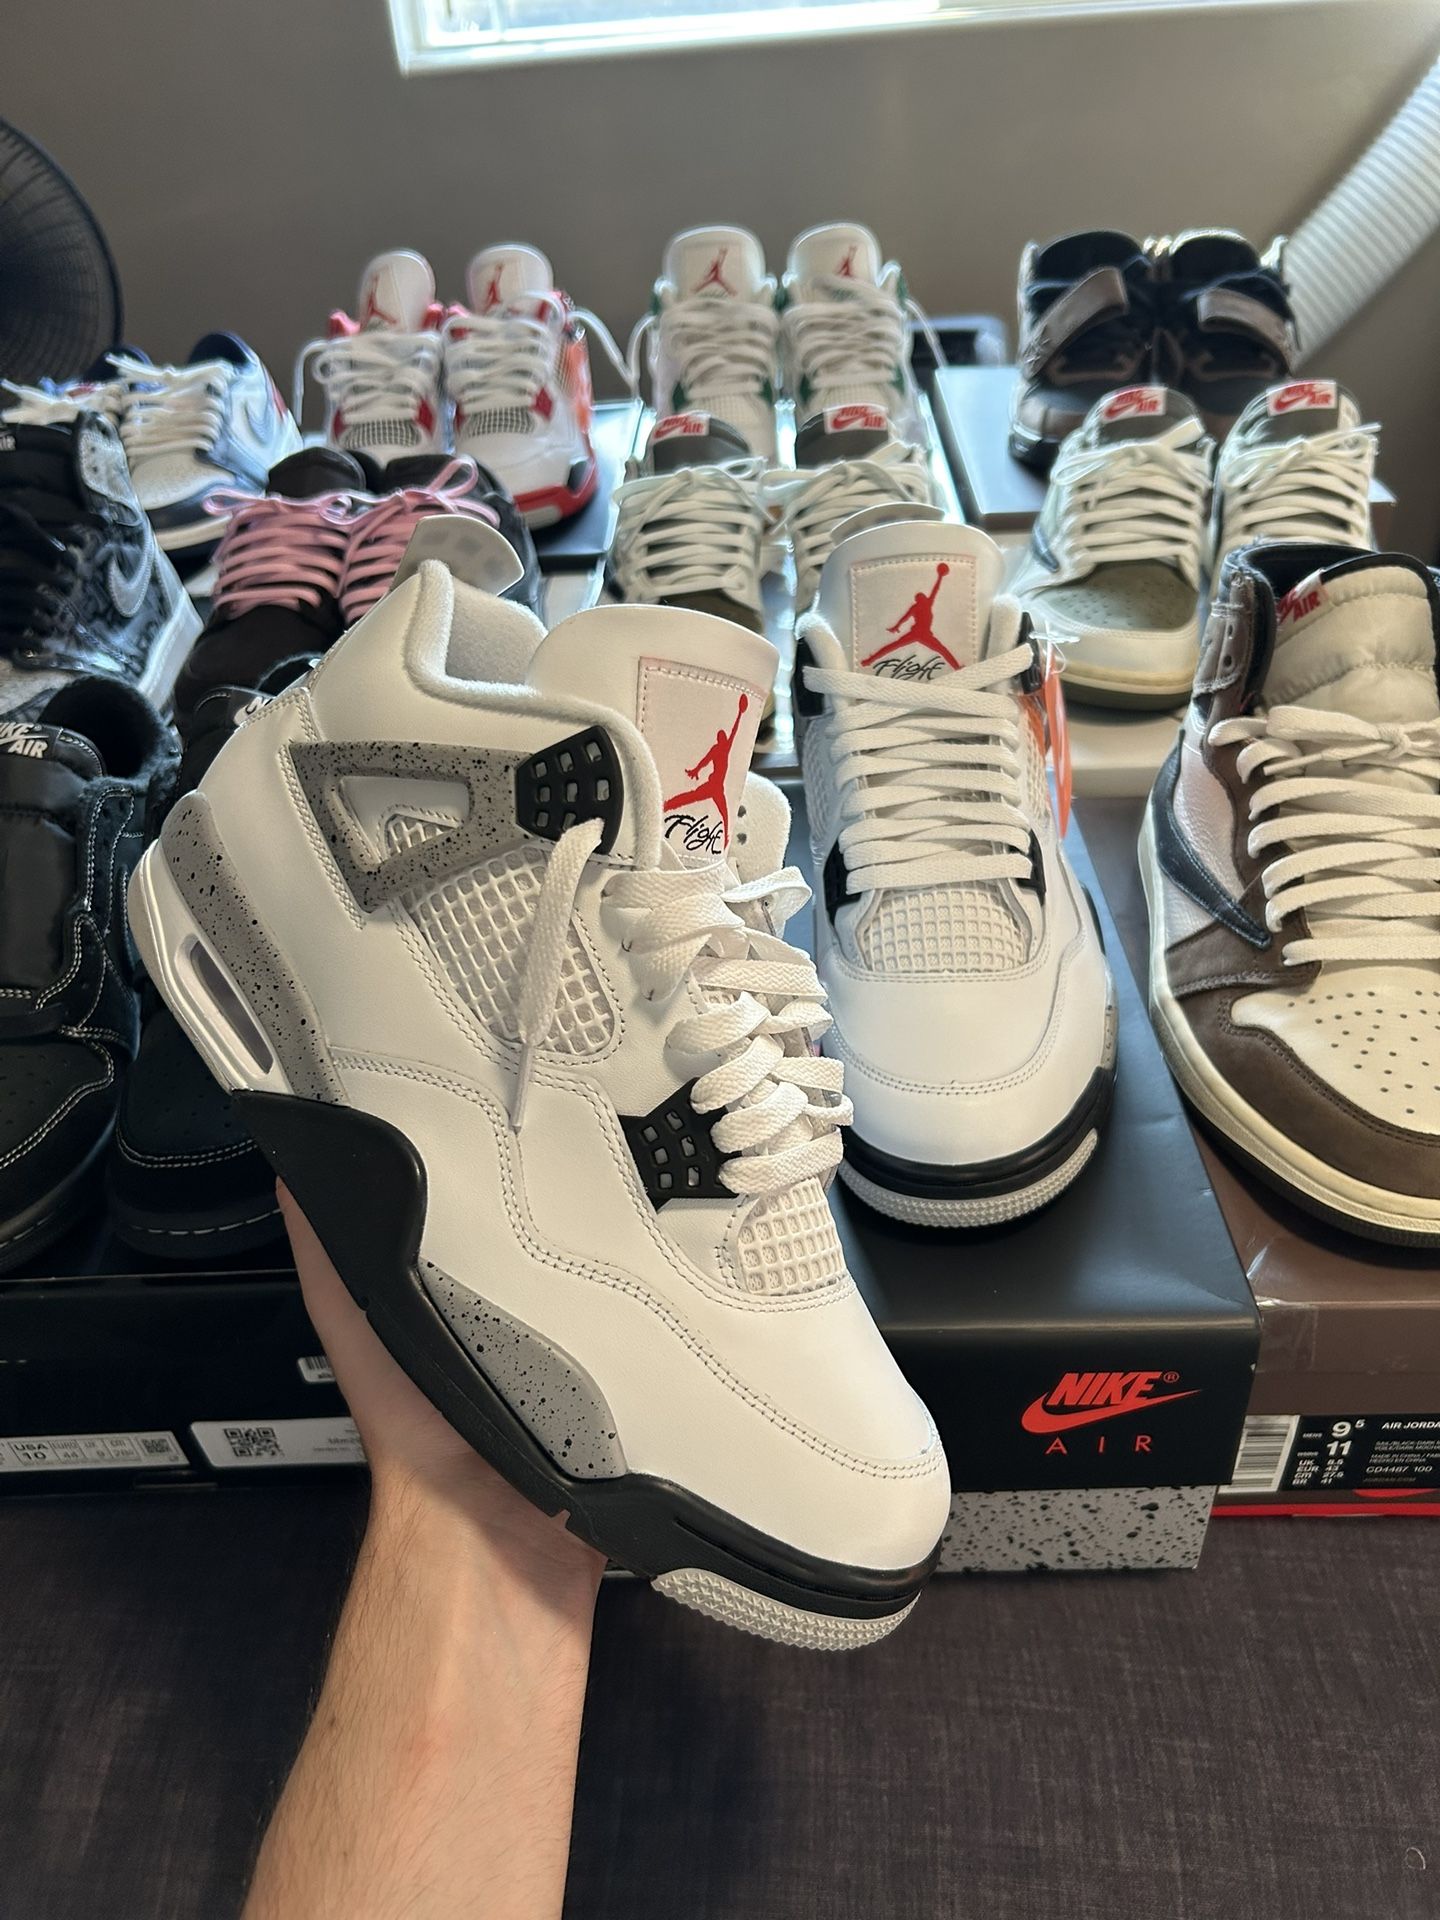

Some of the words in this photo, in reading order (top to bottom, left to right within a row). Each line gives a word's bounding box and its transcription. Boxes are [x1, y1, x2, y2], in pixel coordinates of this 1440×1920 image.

[7, 739, 48, 759] AIR
[1381, 1421, 1402, 1429] AIR
[14, 1443, 48, 1451] USA
[1044, 1435, 1152, 1455] AIR
[1326, 1440, 1352, 1456] 11
[22, 1451, 47, 1460] 10
